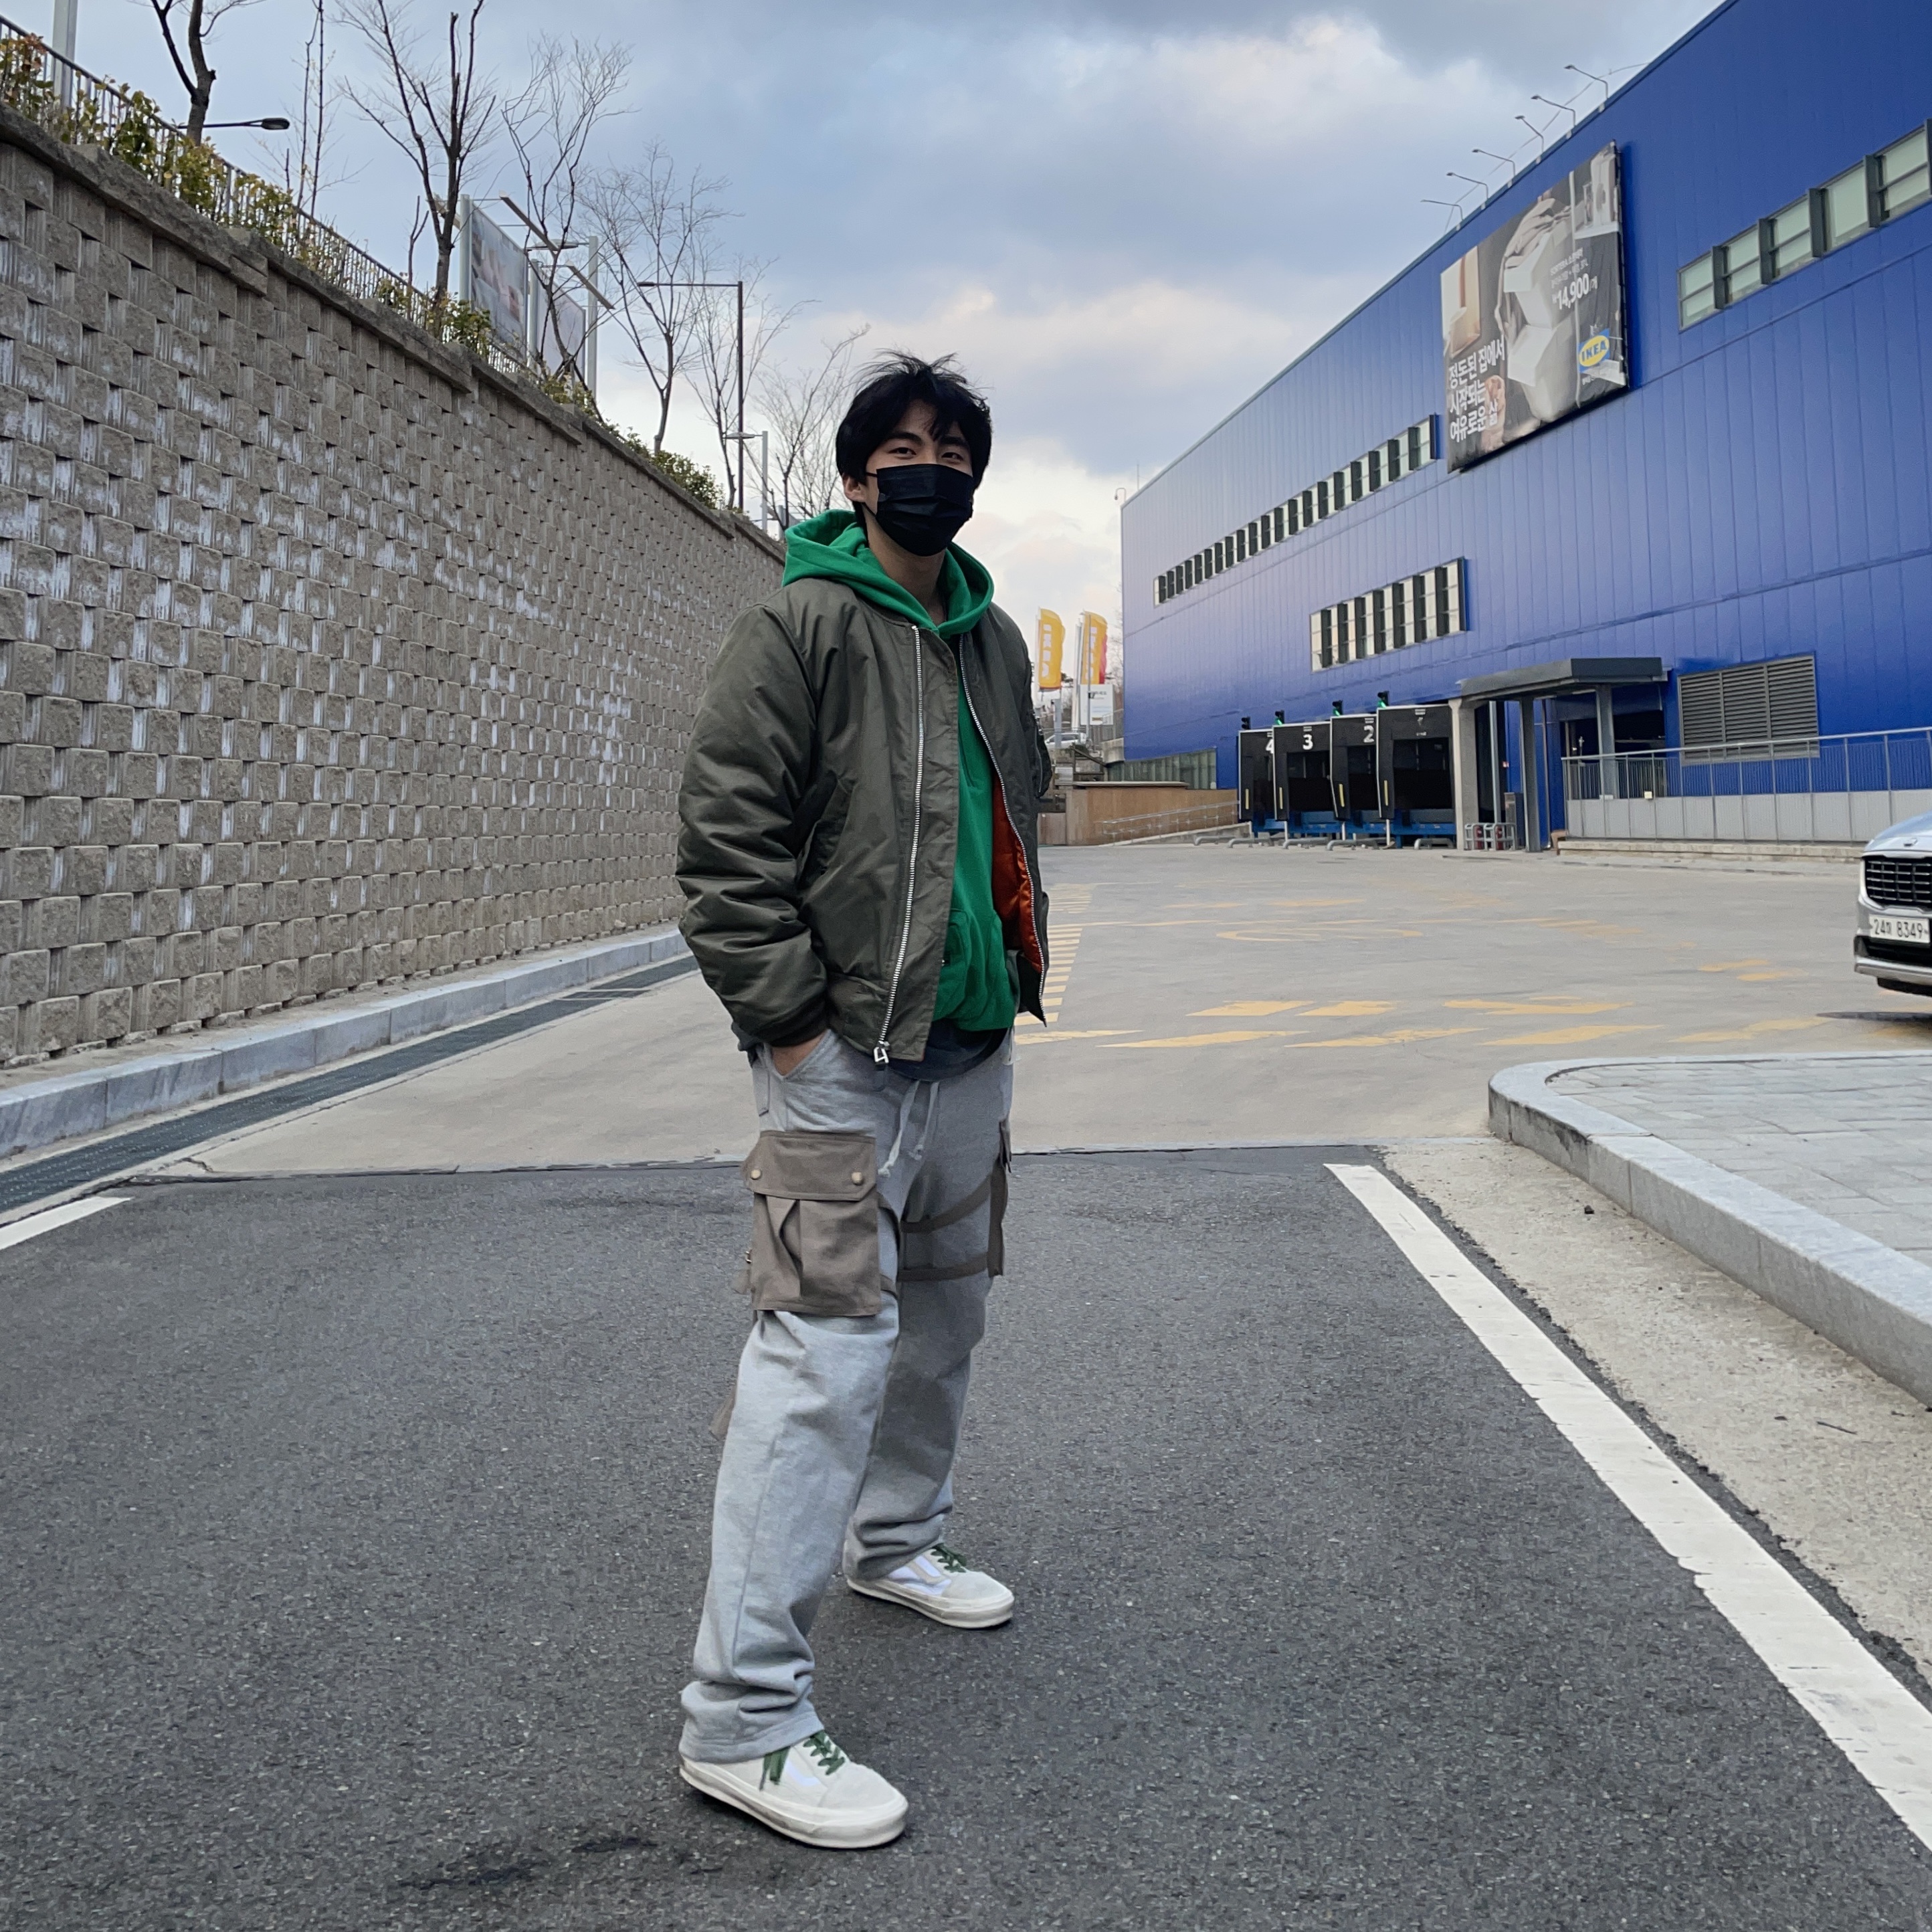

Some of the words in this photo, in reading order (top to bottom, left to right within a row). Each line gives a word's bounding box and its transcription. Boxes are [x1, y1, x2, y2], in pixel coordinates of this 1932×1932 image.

[1449, 352, 1477, 389] 정돈된
[1478, 335, 1505, 373] 집에서
[1581, 340, 1607, 362] IKEA
[1450, 379, 1486, 415] 시작되는
[1450, 405, 1486, 442] 여유로운
[1302, 734, 1313, 750] 3
[1363, 725, 1375, 743] 2
